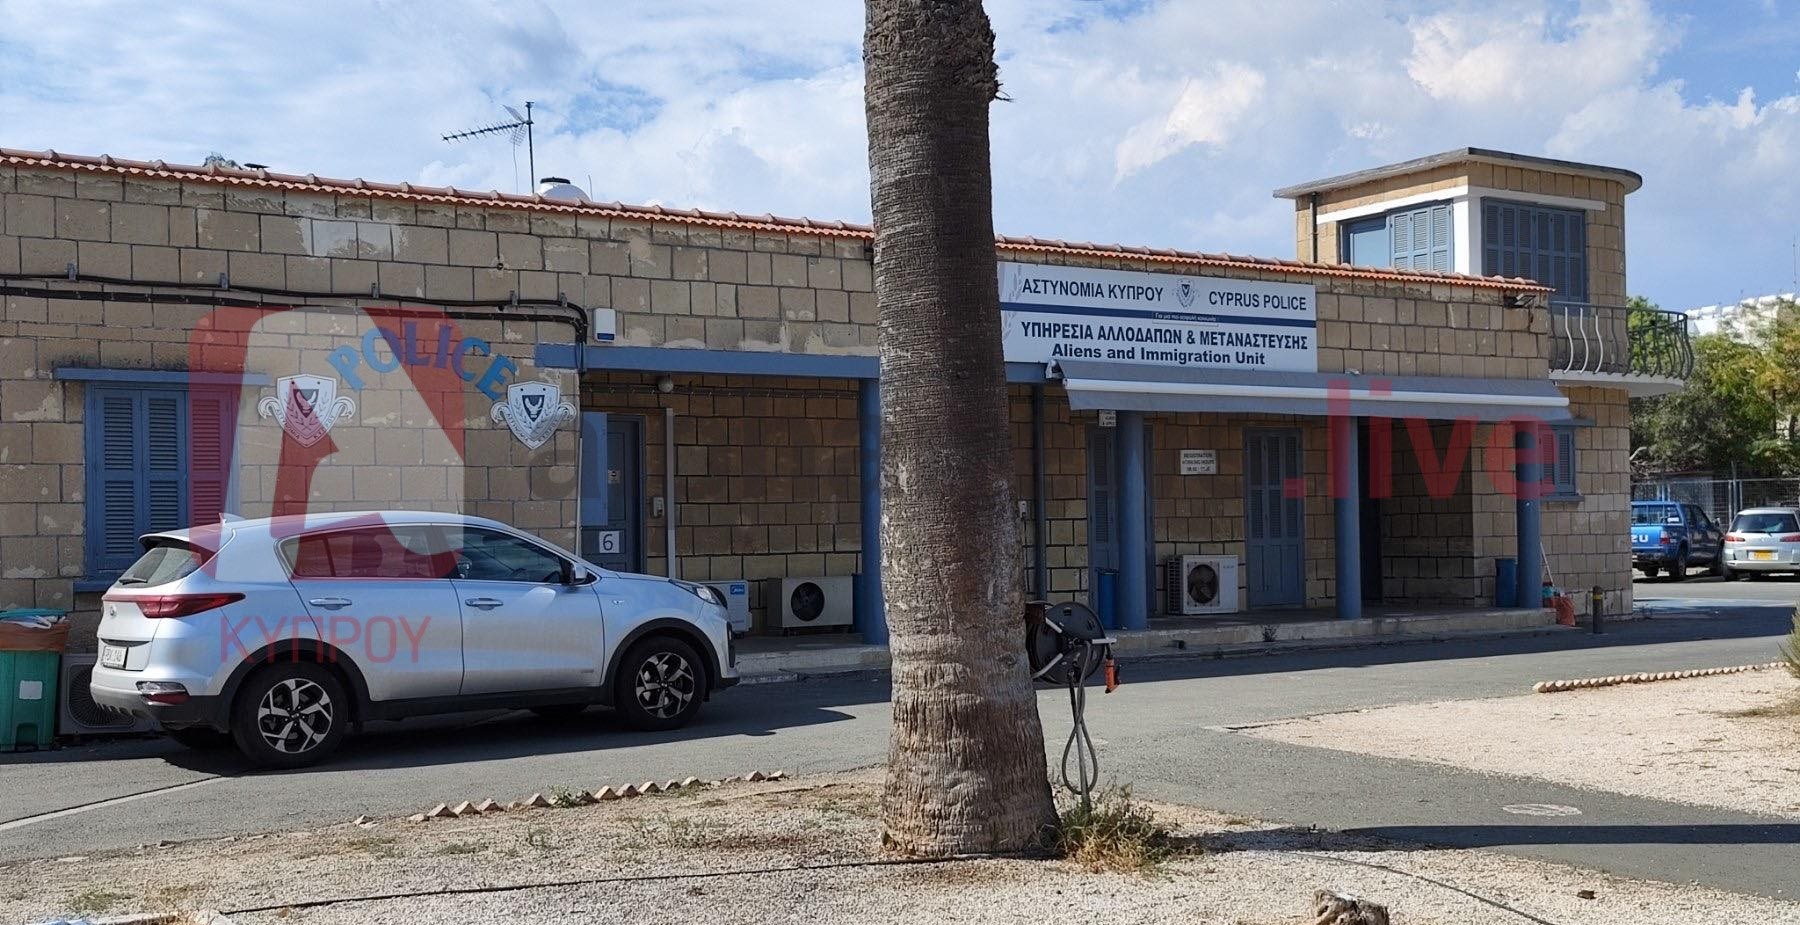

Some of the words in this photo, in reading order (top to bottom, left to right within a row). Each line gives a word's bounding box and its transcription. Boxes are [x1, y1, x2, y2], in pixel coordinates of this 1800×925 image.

[1022, 278, 1105, 299] ΑΣΤΥΝΟΜΙΑ
[1108, 284, 1164, 302] ΚΥΠΡΟΥ
[1209, 291, 1260, 308] CYPRUS
[1263, 294, 1307, 311] POLICE
[1021, 321, 1093, 340] ΥΠΗΡΕΣΙΑ
[1097, 325, 1182, 344] ΑΛΛΟΔΑΠΩΝ
[1186, 330, 1196, 345] &
[1200, 330, 1308, 350] ΜΕΤΑΝΑΣΤΕΥΣΗΣ
[325, 321, 518, 401] POLICE
[1052, 343, 1102, 358] Aliens
[1107, 347, 1135, 360] and
[1141, 347, 1230, 365] Immigration
[1236, 351, 1265, 365] Unit
[603, 533, 613, 551] 6
